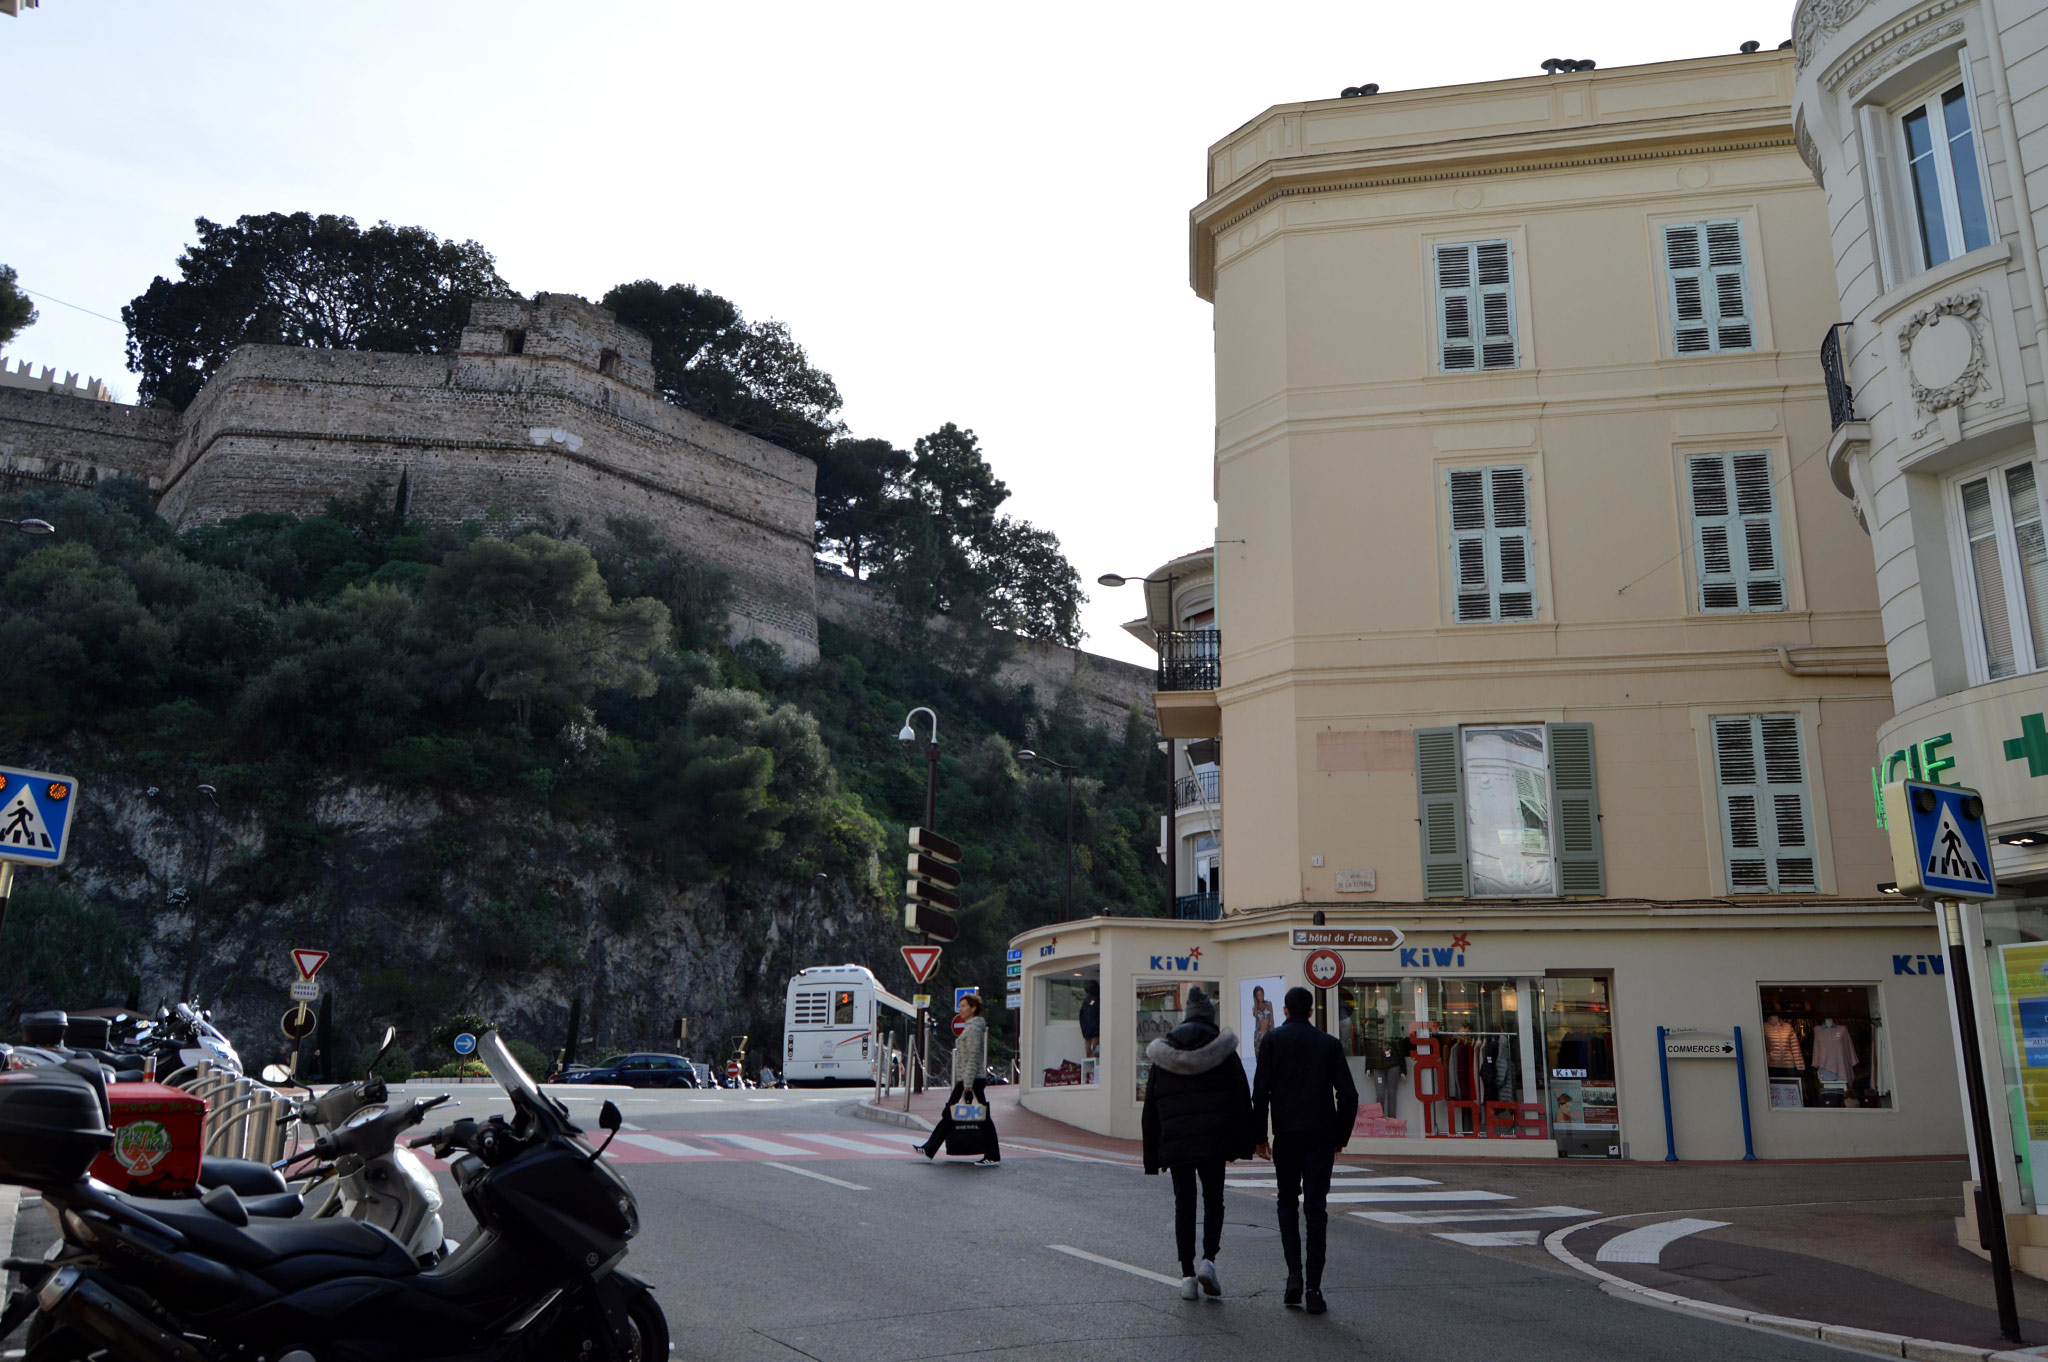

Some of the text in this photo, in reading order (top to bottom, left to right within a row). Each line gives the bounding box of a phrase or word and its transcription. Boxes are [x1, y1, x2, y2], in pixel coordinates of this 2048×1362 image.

[1309, 933, 1378, 942] hôtel de France
[1150, 951, 1199, 971] KiWi
[1400, 942, 1466, 967] KiWi
[1893, 955, 1944, 975] KiW
[842, 993, 849, 1004] 3
[1667, 1045, 1720, 1053] COMMERCES
